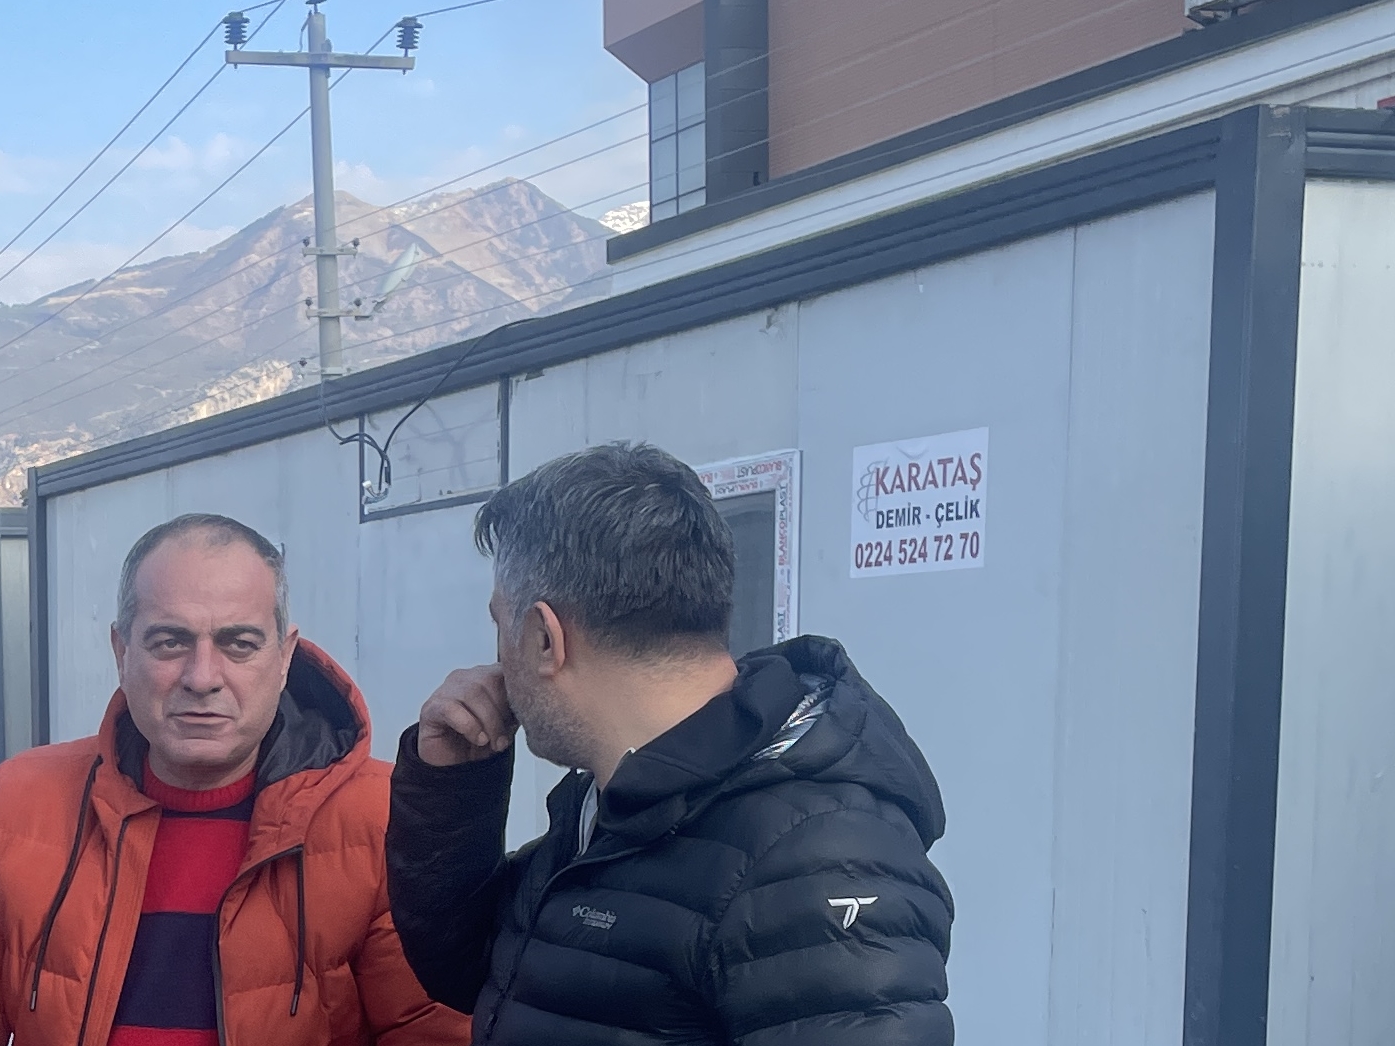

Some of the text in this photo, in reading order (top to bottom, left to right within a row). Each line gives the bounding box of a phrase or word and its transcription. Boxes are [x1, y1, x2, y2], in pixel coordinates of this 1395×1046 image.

[874, 452, 983, 497] KARATAŞ
[778, 484, 788, 567] BLANCOPLAST
[875, 502, 922, 530] DEMİR
[934, 495, 981, 529] ÇELİK
[855, 531, 980, 570] 0224 524 72 70
